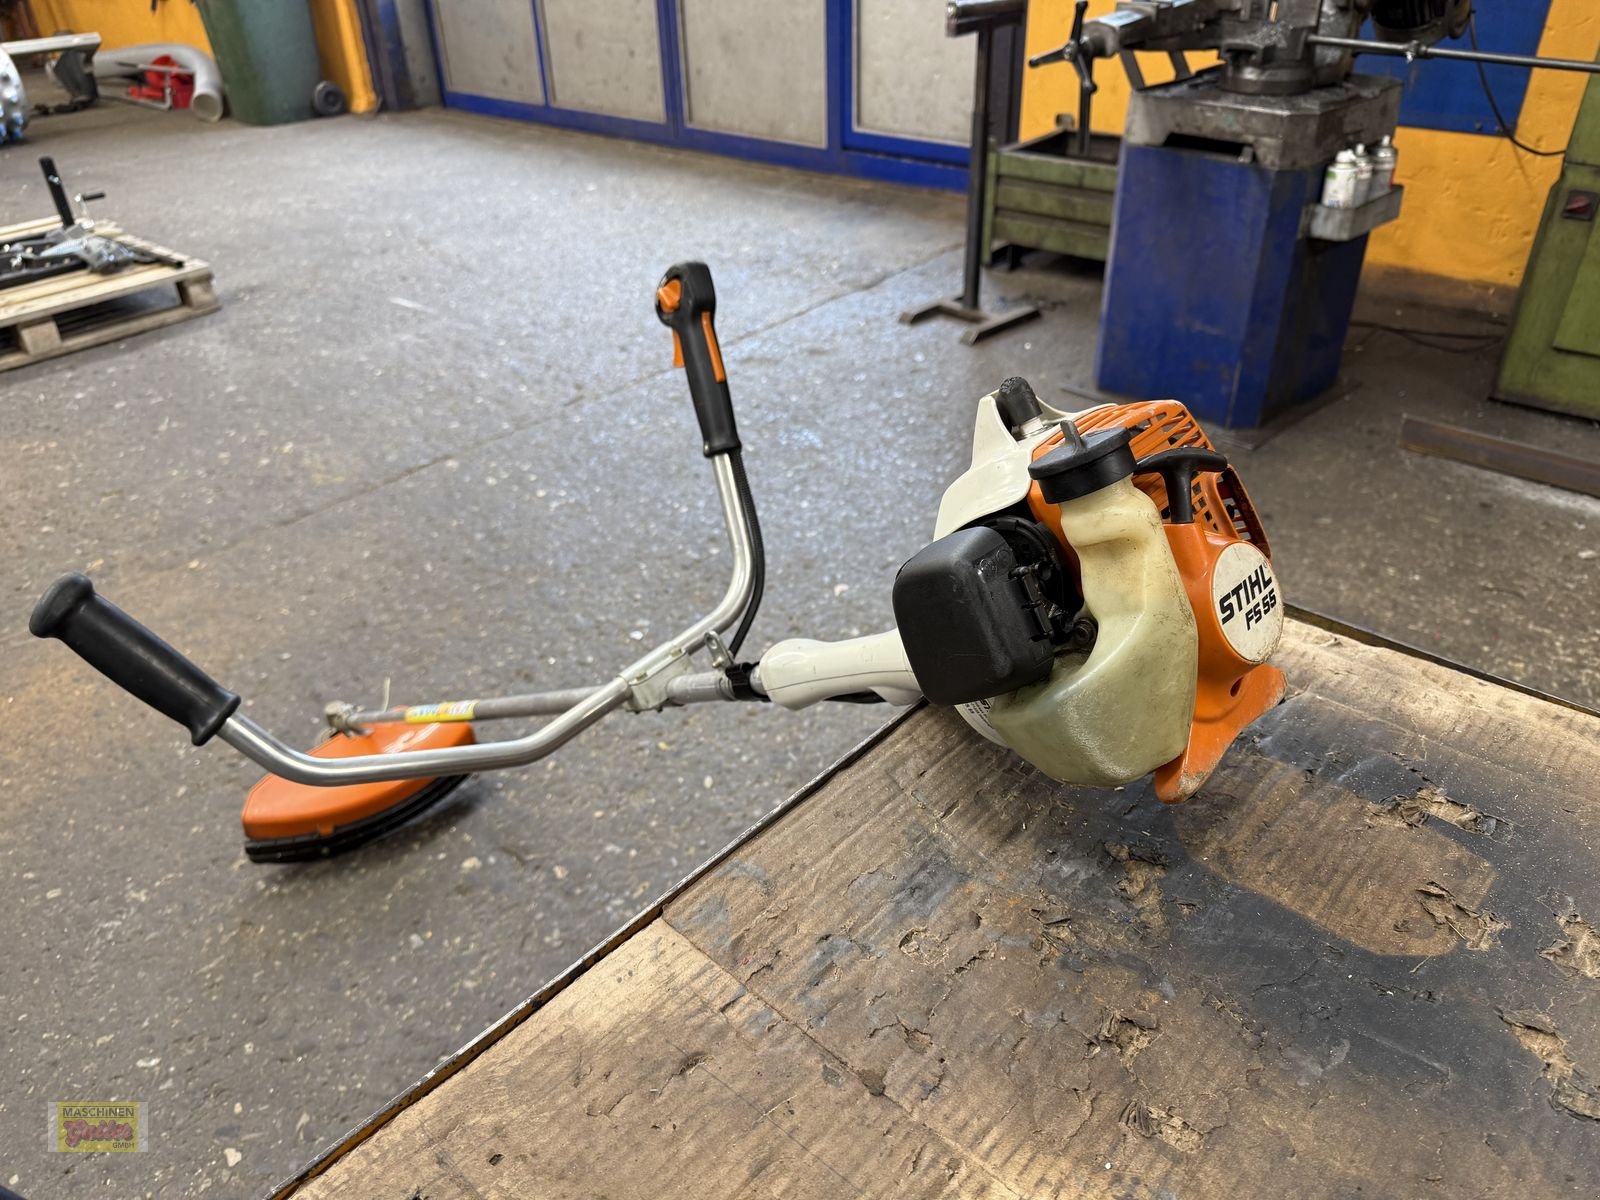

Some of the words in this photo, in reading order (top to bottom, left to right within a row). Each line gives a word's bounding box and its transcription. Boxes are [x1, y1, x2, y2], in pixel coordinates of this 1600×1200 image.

[1219, 564, 1273, 625] STIHL
[1245, 602, 1262, 631] FS
[1261, 588, 1277, 616] 55
